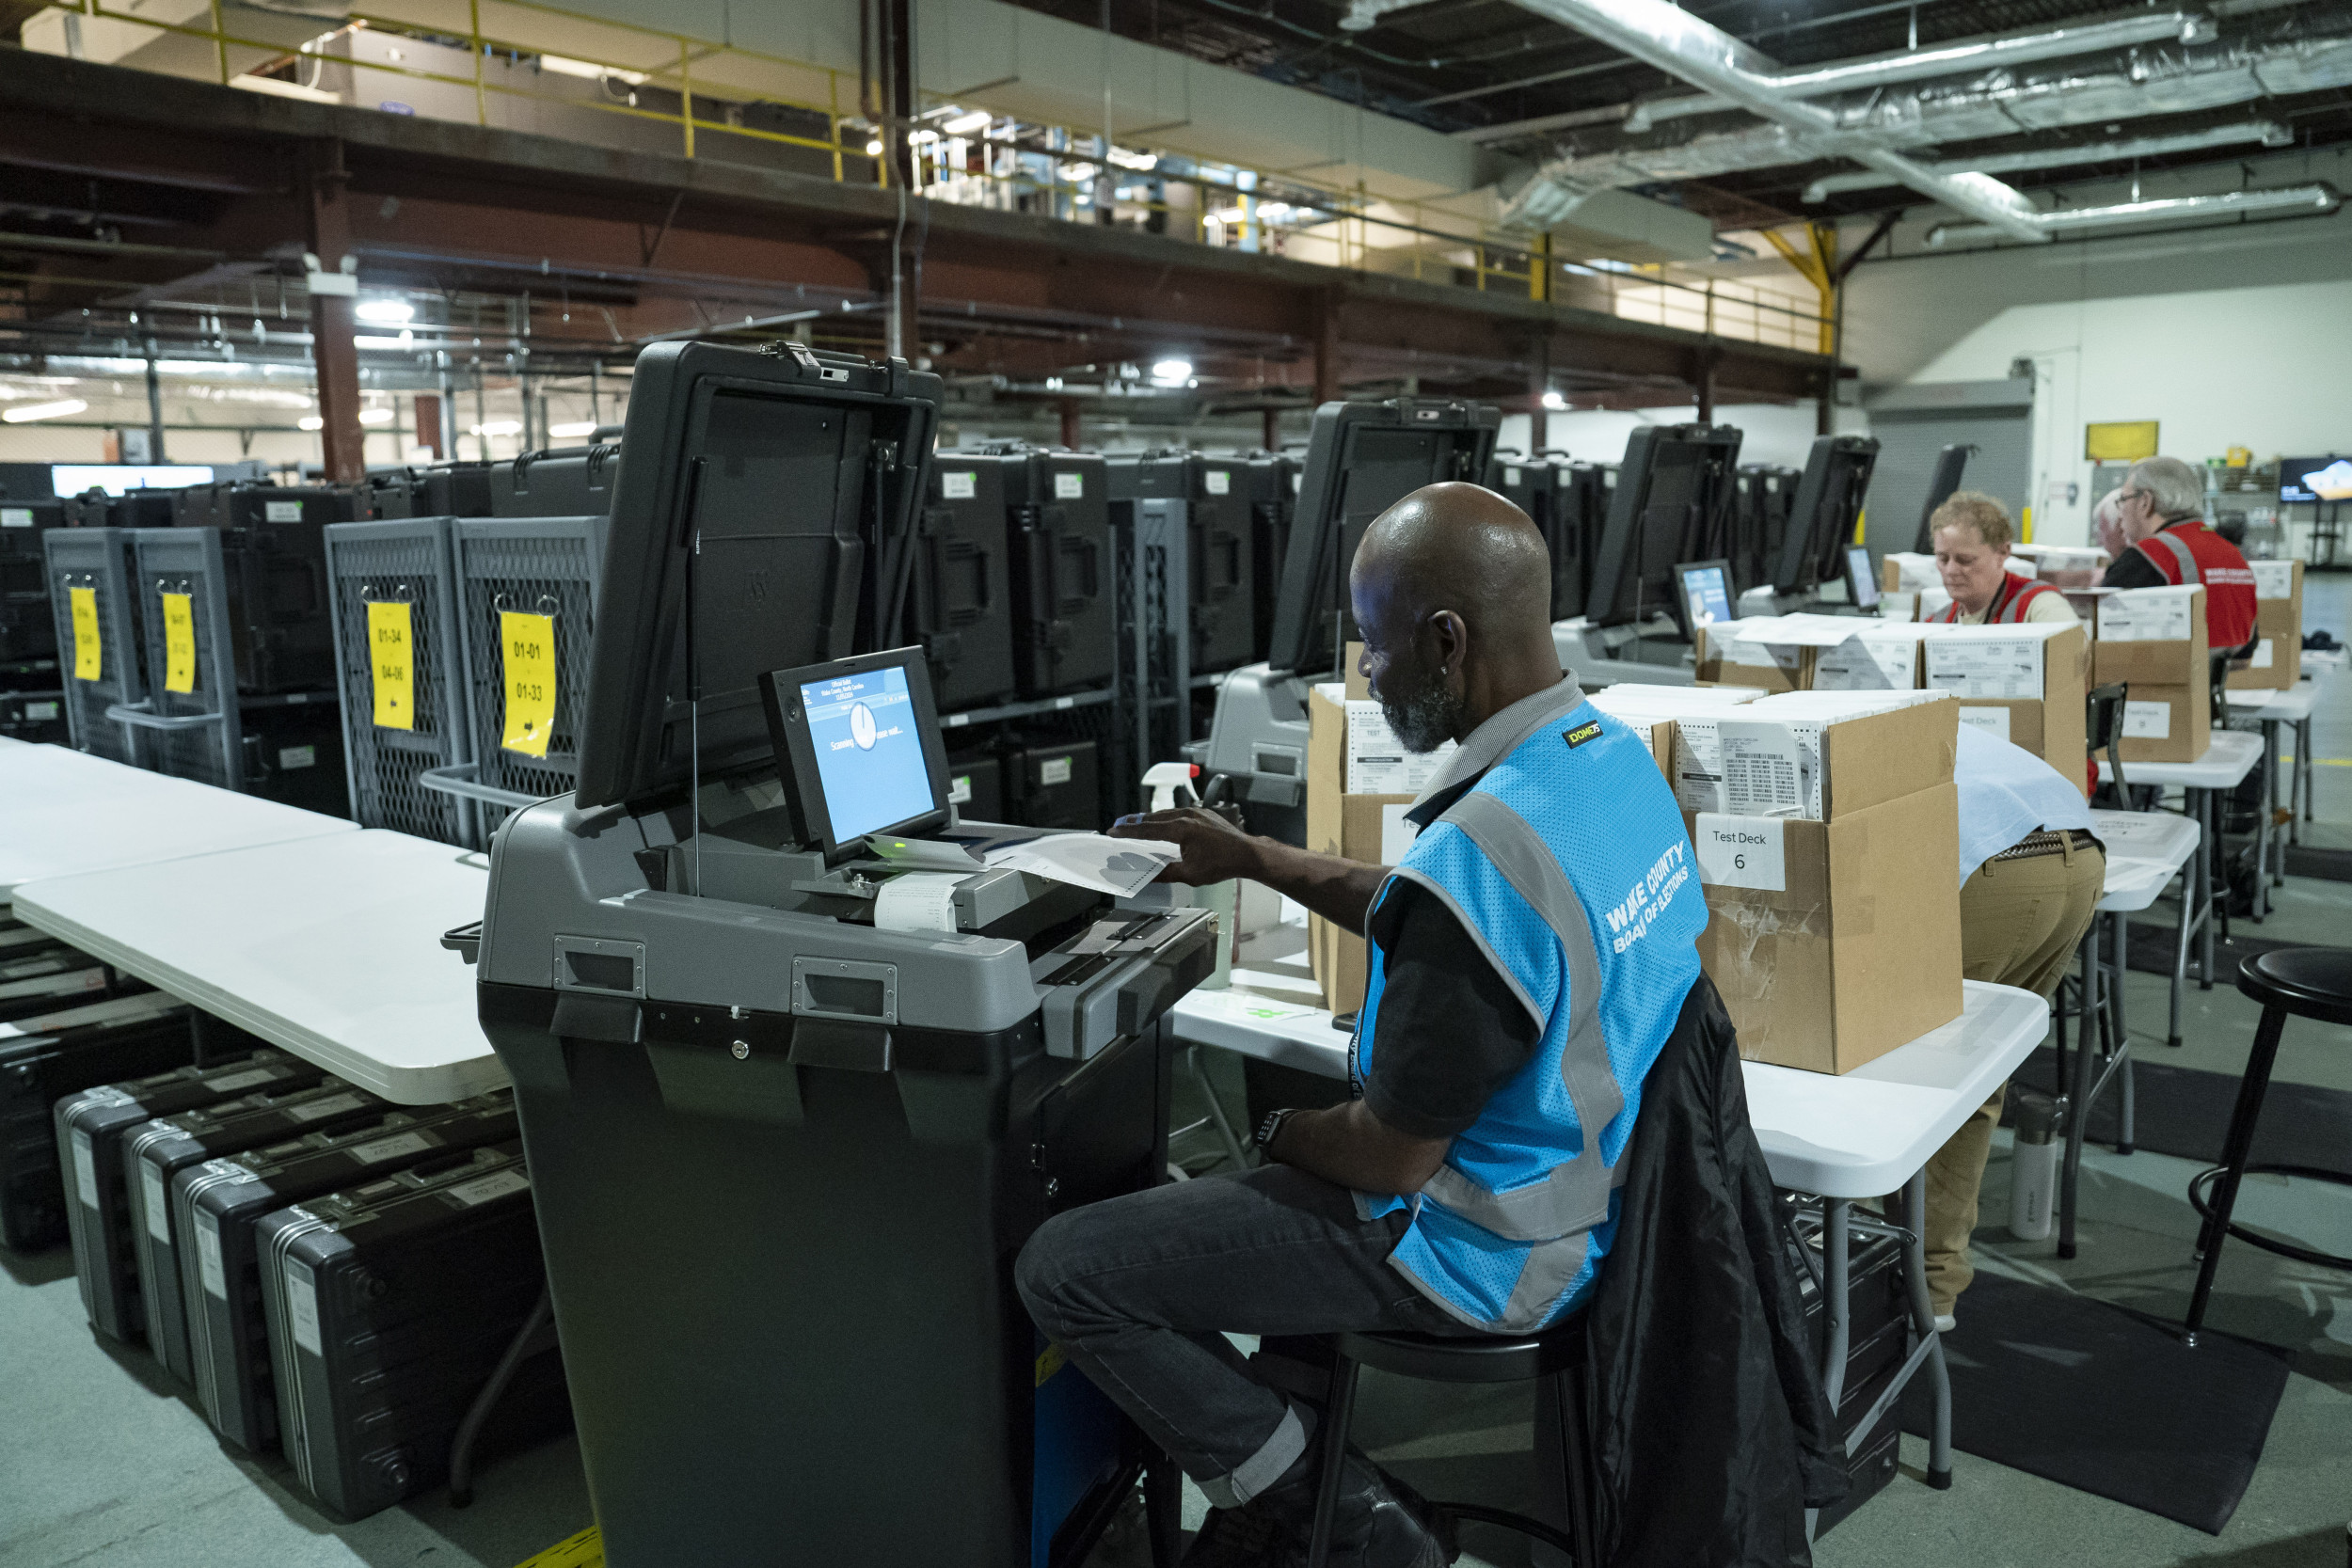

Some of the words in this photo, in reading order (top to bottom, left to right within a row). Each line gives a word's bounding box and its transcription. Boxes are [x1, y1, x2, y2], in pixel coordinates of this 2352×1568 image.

[378, 628, 402, 643] 01-34
[514, 641, 541, 659] 01-01
[382, 664, 404, 680] 04-06
[516, 683, 542, 702] 01-33
[830, 738, 854, 751] Scanning
[1401, 818, 1421, 829] Te
[1712, 831, 1737, 843] Test
[1739, 832, 1767, 845] Deck
[1734, 854, 1745, 869] 6
[1605, 881, 1648, 933] WAKE
[1646, 840, 1684, 894] COUNTY
[1613, 919, 1647, 954] BOA
[1645, 901, 1659, 924] OF
[1659, 864, 1689, 912] ELECTIONS
